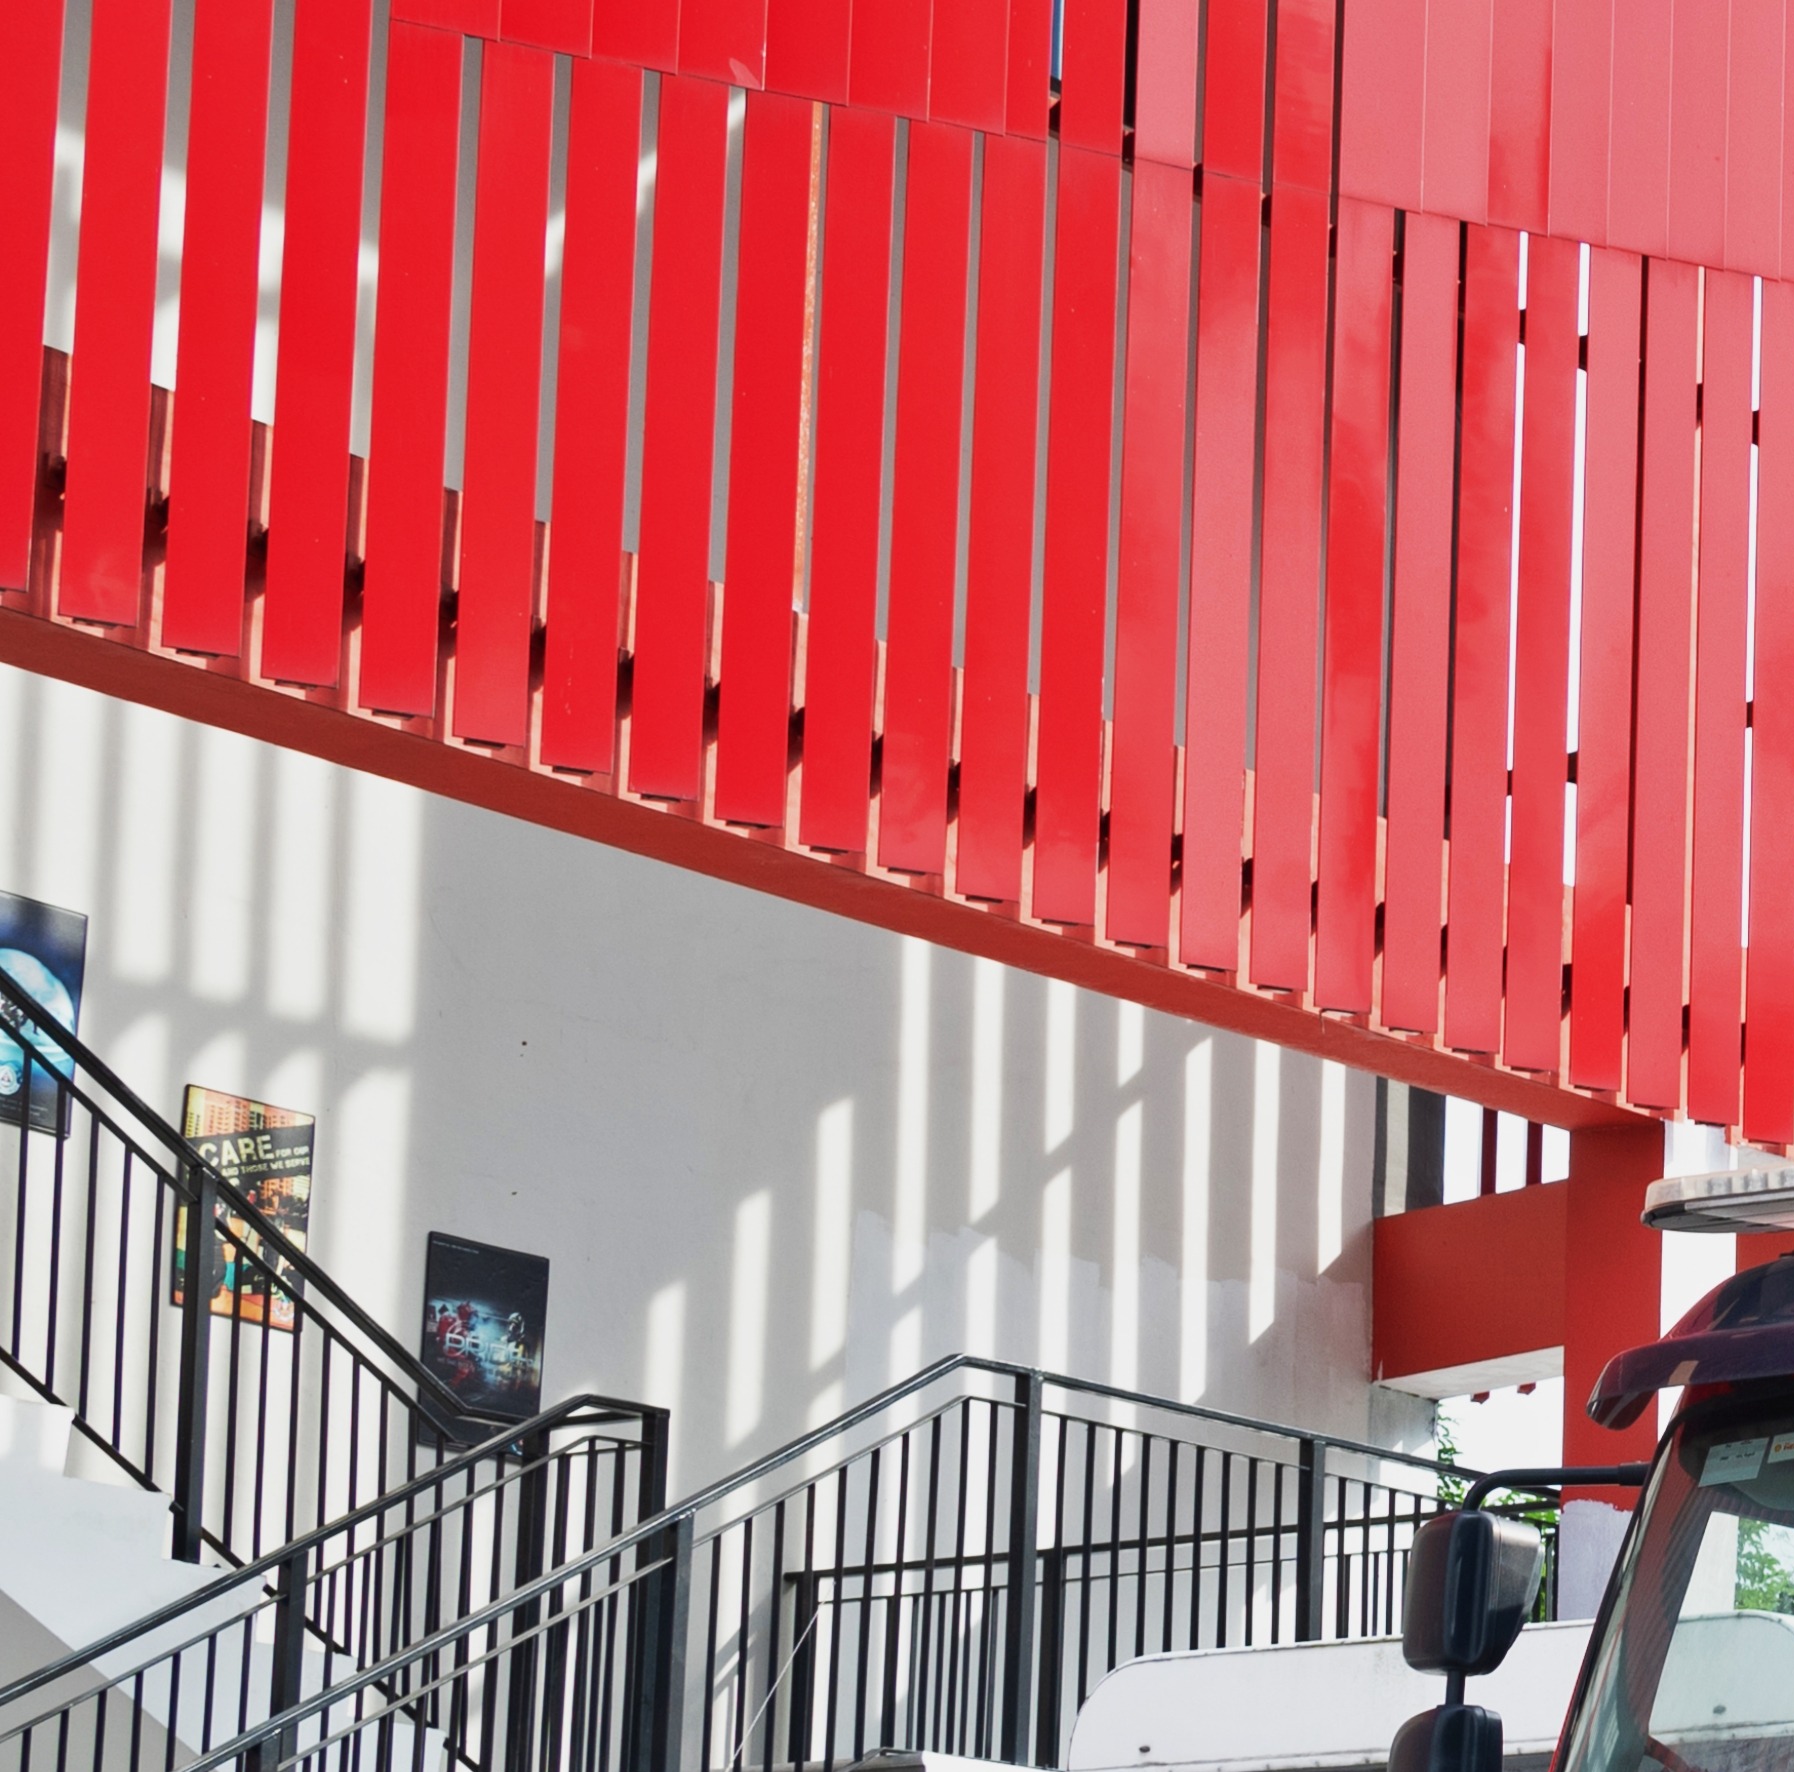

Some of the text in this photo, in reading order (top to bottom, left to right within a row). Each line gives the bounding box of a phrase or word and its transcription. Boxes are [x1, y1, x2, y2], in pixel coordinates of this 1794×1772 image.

[199, 1134, 275, 1168] CARE
[275, 1148, 292, 1158] FOR
[240, 1163, 268, 1174] THOSE
[270, 1160, 284, 1170] WE
[285, 1157, 310, 1168] SERVE
